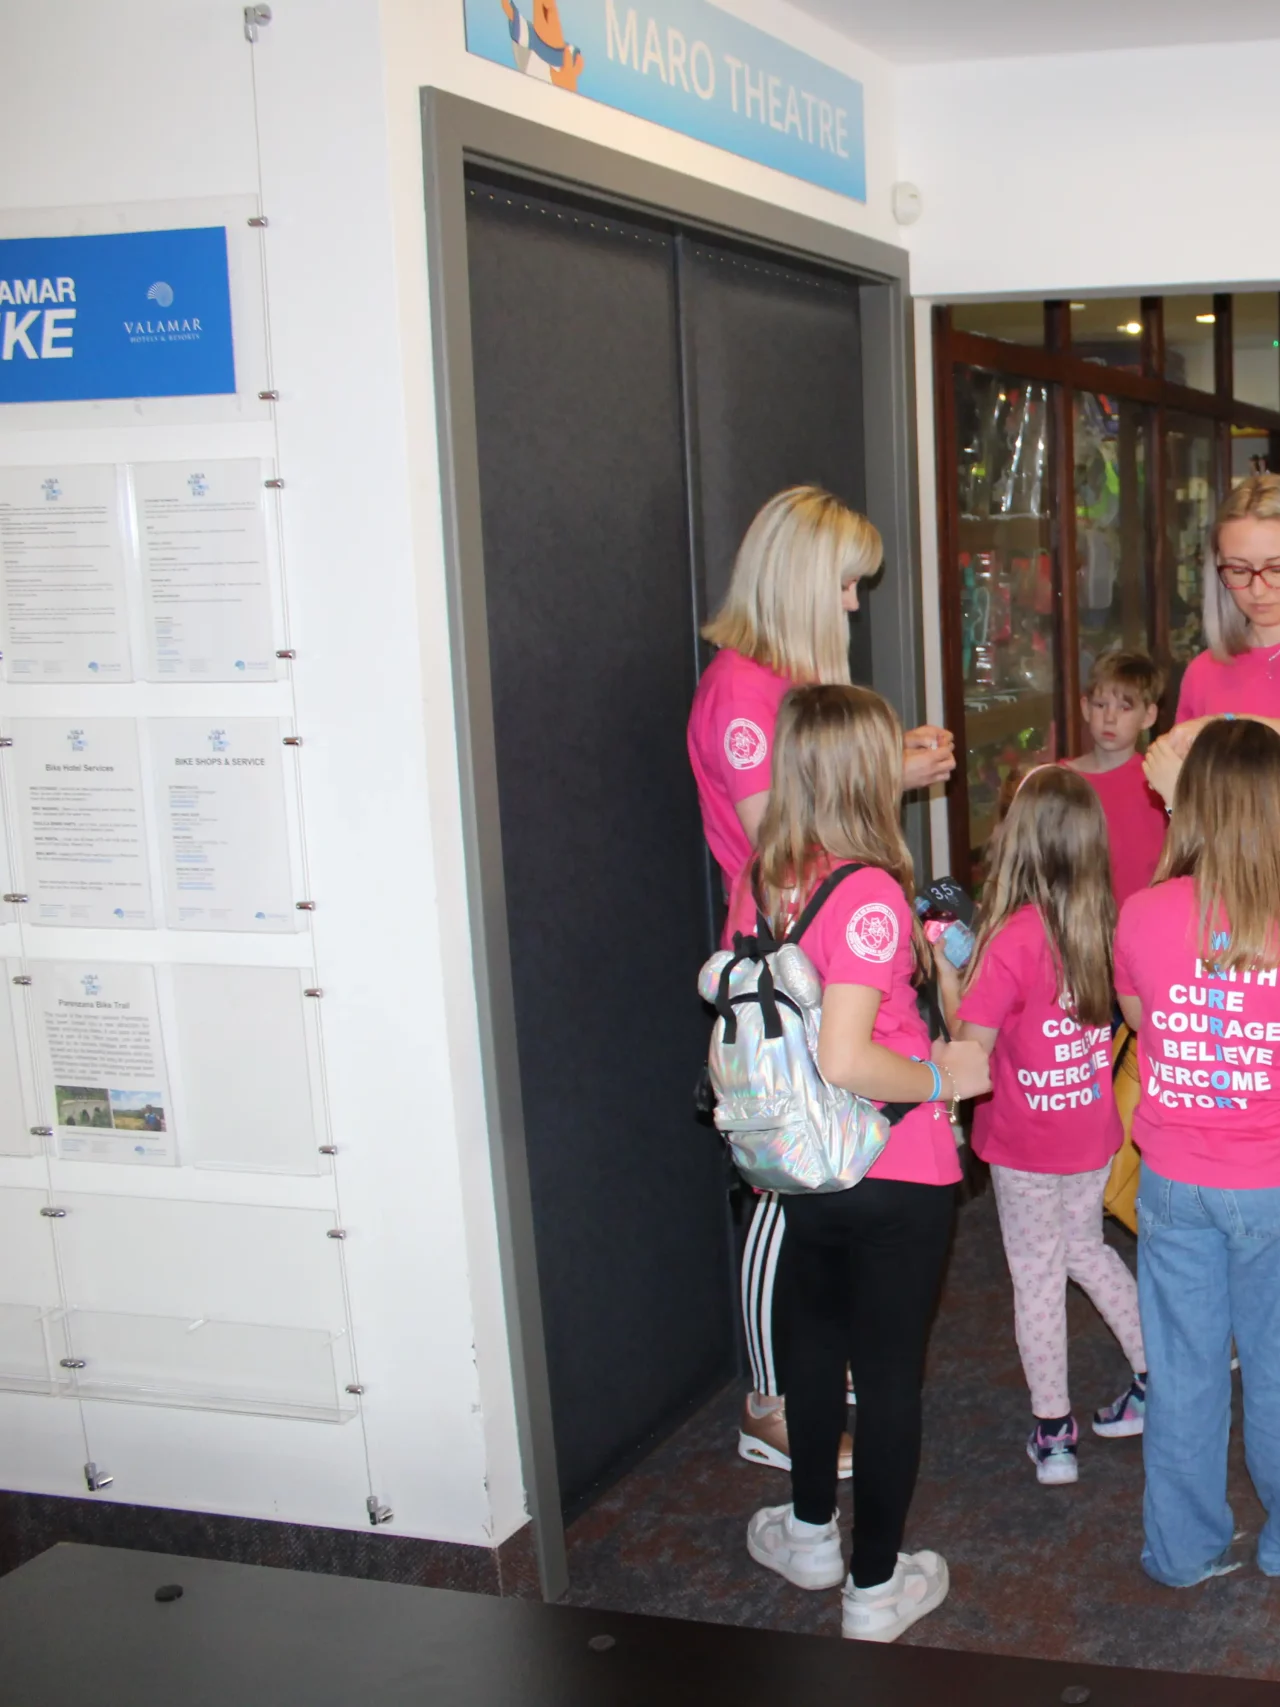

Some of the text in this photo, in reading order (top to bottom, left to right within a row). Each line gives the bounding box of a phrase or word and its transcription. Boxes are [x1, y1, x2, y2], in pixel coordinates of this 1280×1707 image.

[605, 0, 849, 158] MARO THEATRE
[0, 308, 77, 360] KE
[123, 318, 202, 334] VALAMAR
[175, 758, 193, 766] BIKE
[195, 758, 222, 766] SHOPS
[232, 758, 265, 766] SERVICE
[1169, 984, 1244, 1012] CURE
[1162, 1039, 1274, 1066] BELIEVE
[1018, 1050, 1110, 1088] OVERCE
[1148, 1055, 1272, 1092] VERCOME
